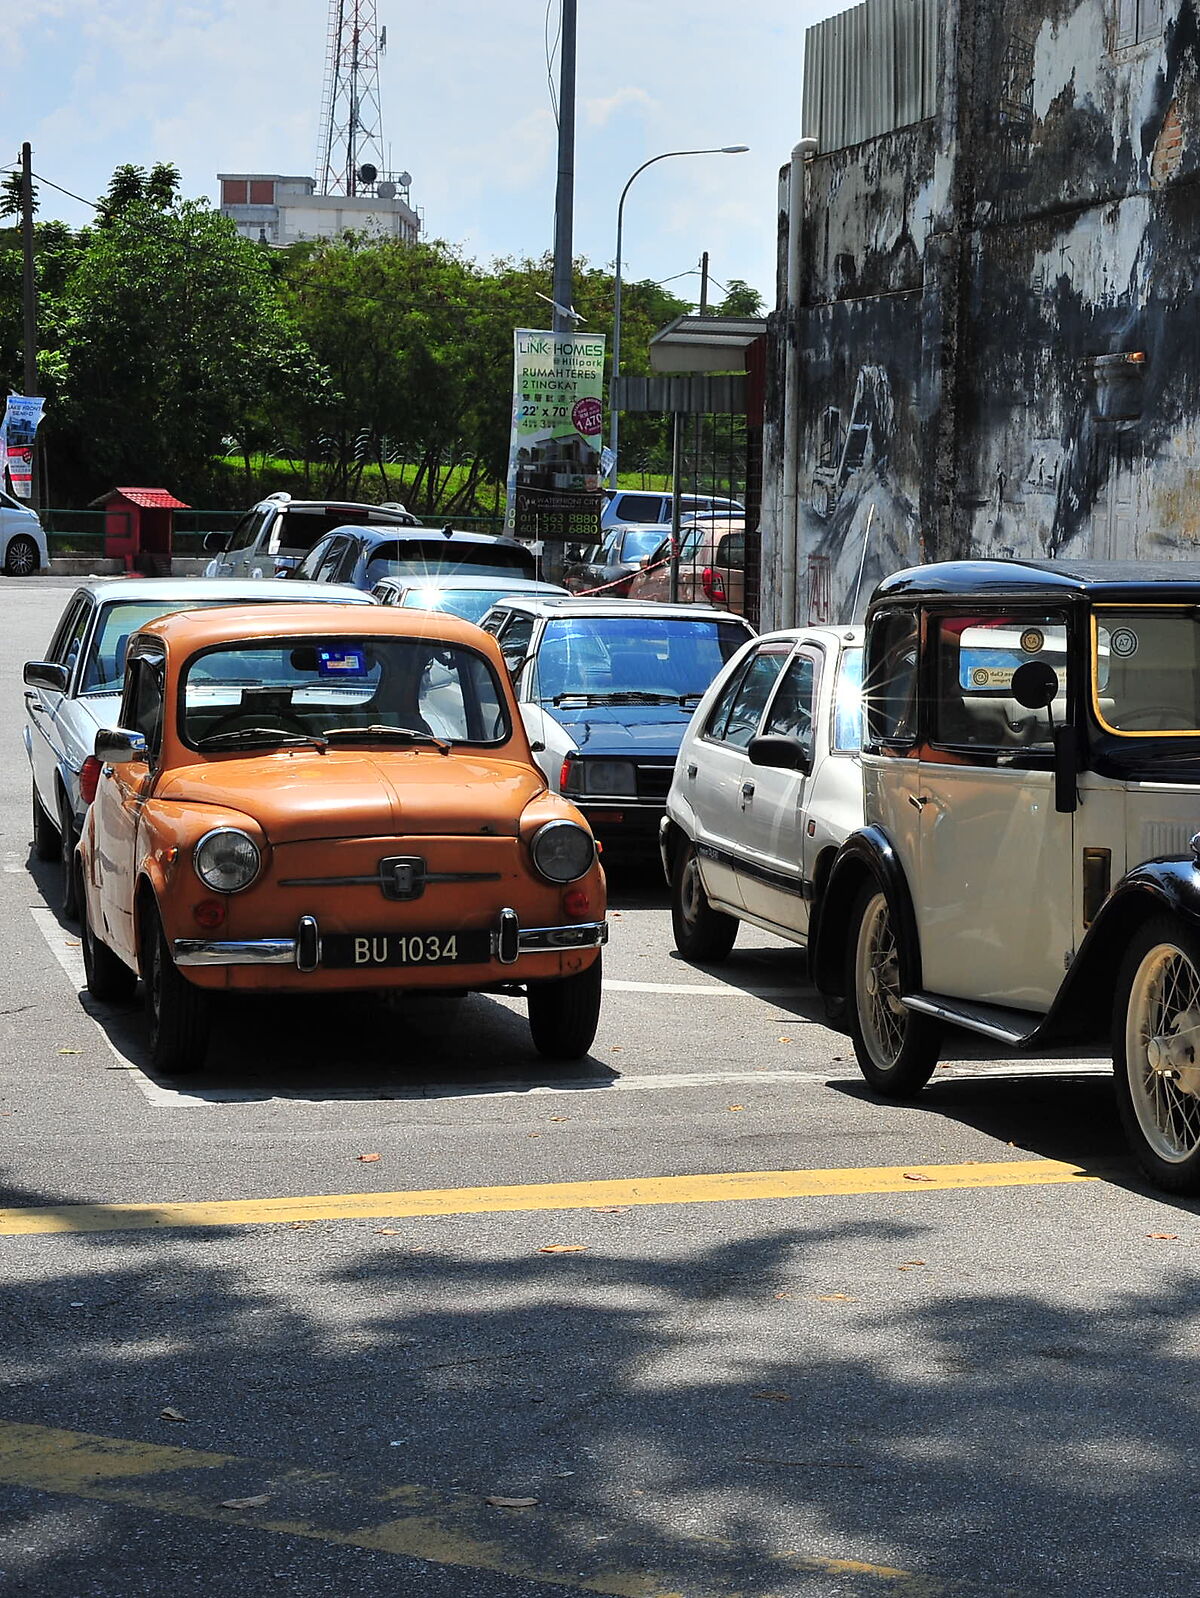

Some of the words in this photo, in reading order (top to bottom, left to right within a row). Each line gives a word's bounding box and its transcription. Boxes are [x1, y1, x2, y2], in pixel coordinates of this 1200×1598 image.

[553, 343, 603, 357] HOMES
[522, 367, 563, 378] RUMAH
[565, 369, 597, 380] TERES
[522, 379, 529, 389] 2
[531, 380, 578, 391] TINGKAT
[522, 405, 539, 416] 22'
[552, 406, 569, 417] 70'
[568, 513, 598, 524] 8880
[568, 524, 598, 535] 6880
[354, 937, 388, 963] BU
[398, 935, 458, 962] 1034
